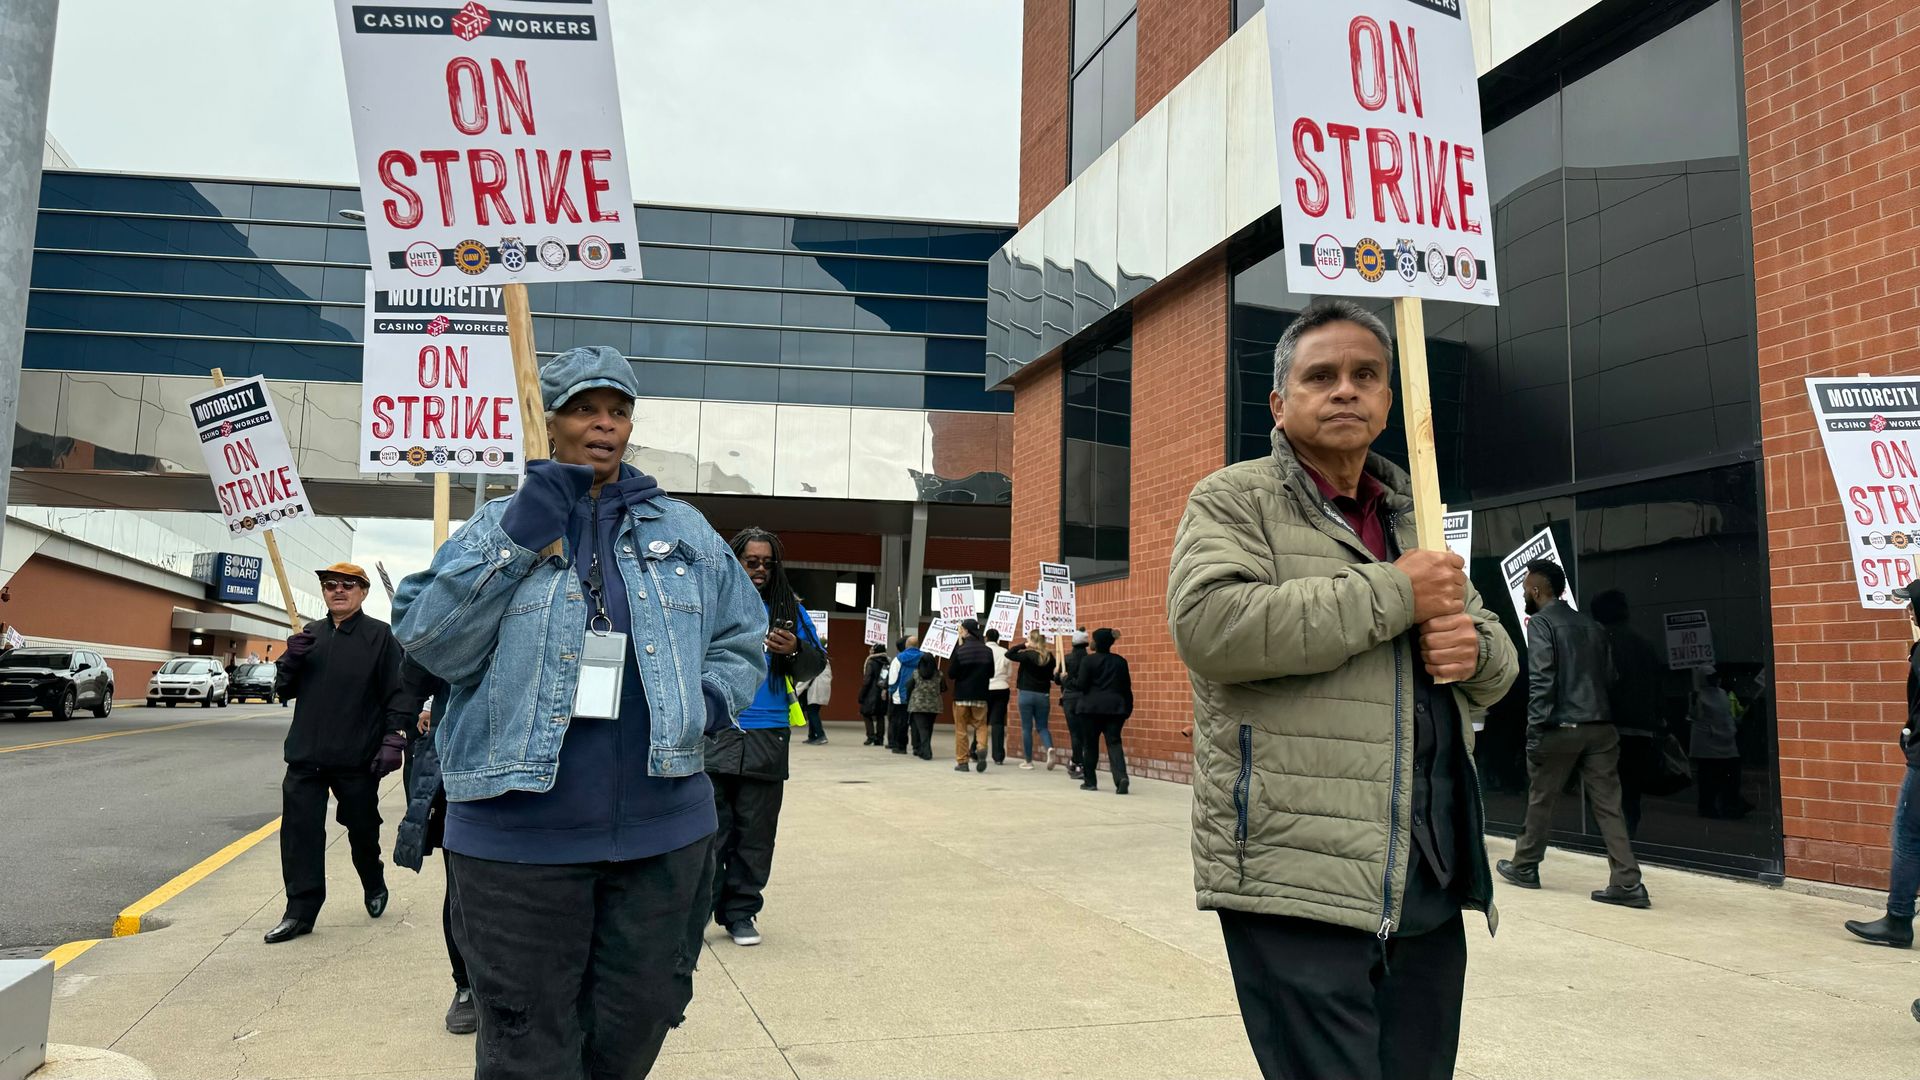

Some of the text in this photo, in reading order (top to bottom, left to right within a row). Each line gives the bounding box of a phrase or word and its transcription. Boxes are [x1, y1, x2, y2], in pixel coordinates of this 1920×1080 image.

[363, 14, 591, 34] CASINO WORKERS
[1348, 15, 1423, 118] ON
[446, 56, 536, 135] ON
[1292, 117, 1482, 235] STRIKE
[378, 148, 620, 229] STRIKE
[409, 252, 437, 261] UNITE
[410, 258, 438, 267] HERE!
[1317, 247, 1341, 258] UNITE
[1317, 256, 1341, 267] HERE!
[388, 286, 502, 308] MOTORCITY
[379, 323, 423, 331] CASINO
[418, 345, 468, 389] ON
[195, 388, 255, 422] MOTORCITY
[1826, 387, 1918, 407] MOTORCITY
[233, 414, 270, 429] WORKERS
[372, 395, 513, 440] STRIKE
[1830, 421, 1866, 429] CASINO
[223, 438, 259, 475] ON
[1870, 440, 1918, 480] ON
[218, 465, 298, 517] STRIKE
[225, 554, 260, 569] SOUND
[1507, 538, 1546, 575] MOTORCITY
[224, 566, 258, 580] BOARD
[226, 584, 254, 596] ENTRANCE
[951, 593, 964, 605] ON
[942, 605, 974, 618] STRIKE
[1045, 600, 1071, 616] STRIKE
